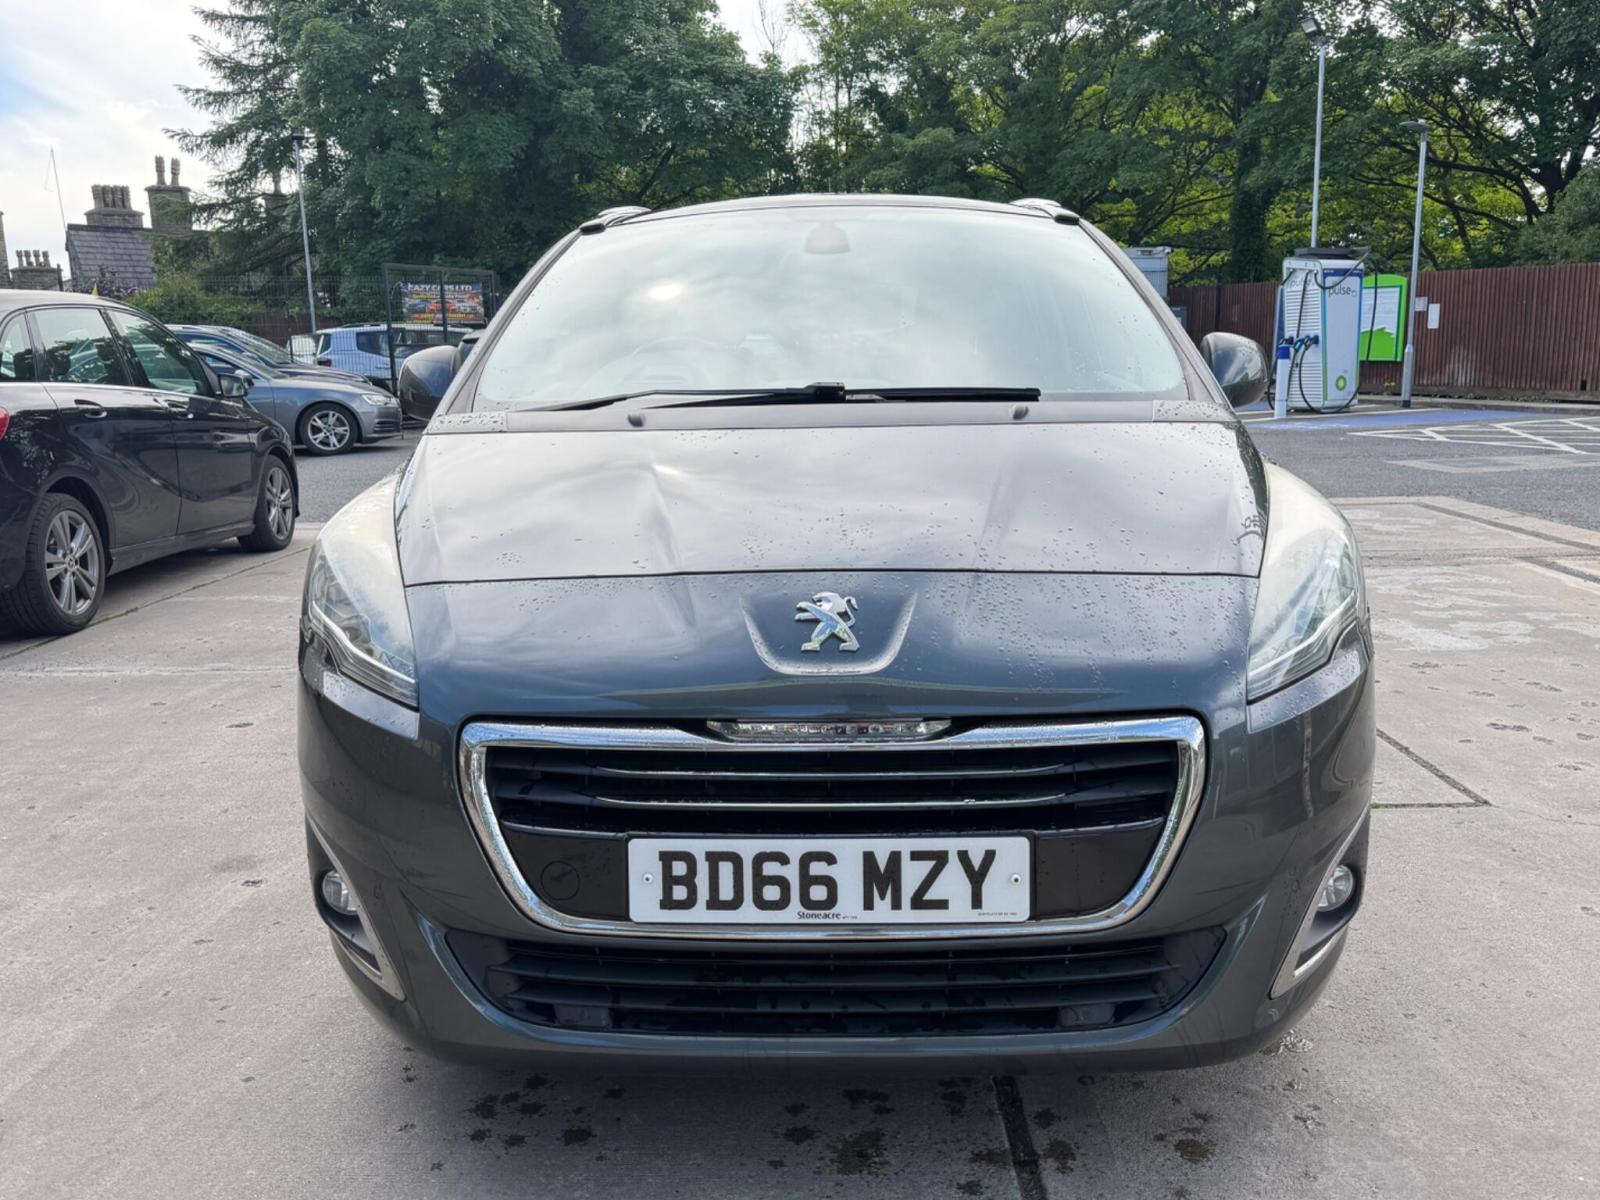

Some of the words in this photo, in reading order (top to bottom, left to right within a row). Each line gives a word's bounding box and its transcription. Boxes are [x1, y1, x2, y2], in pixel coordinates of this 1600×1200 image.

[1328, 285, 1351, 297] pulse
[658, 850, 839, 911] BD66
[863, 849, 996, 911] MZY
[797, 910, 841, 920] Stoneacre
